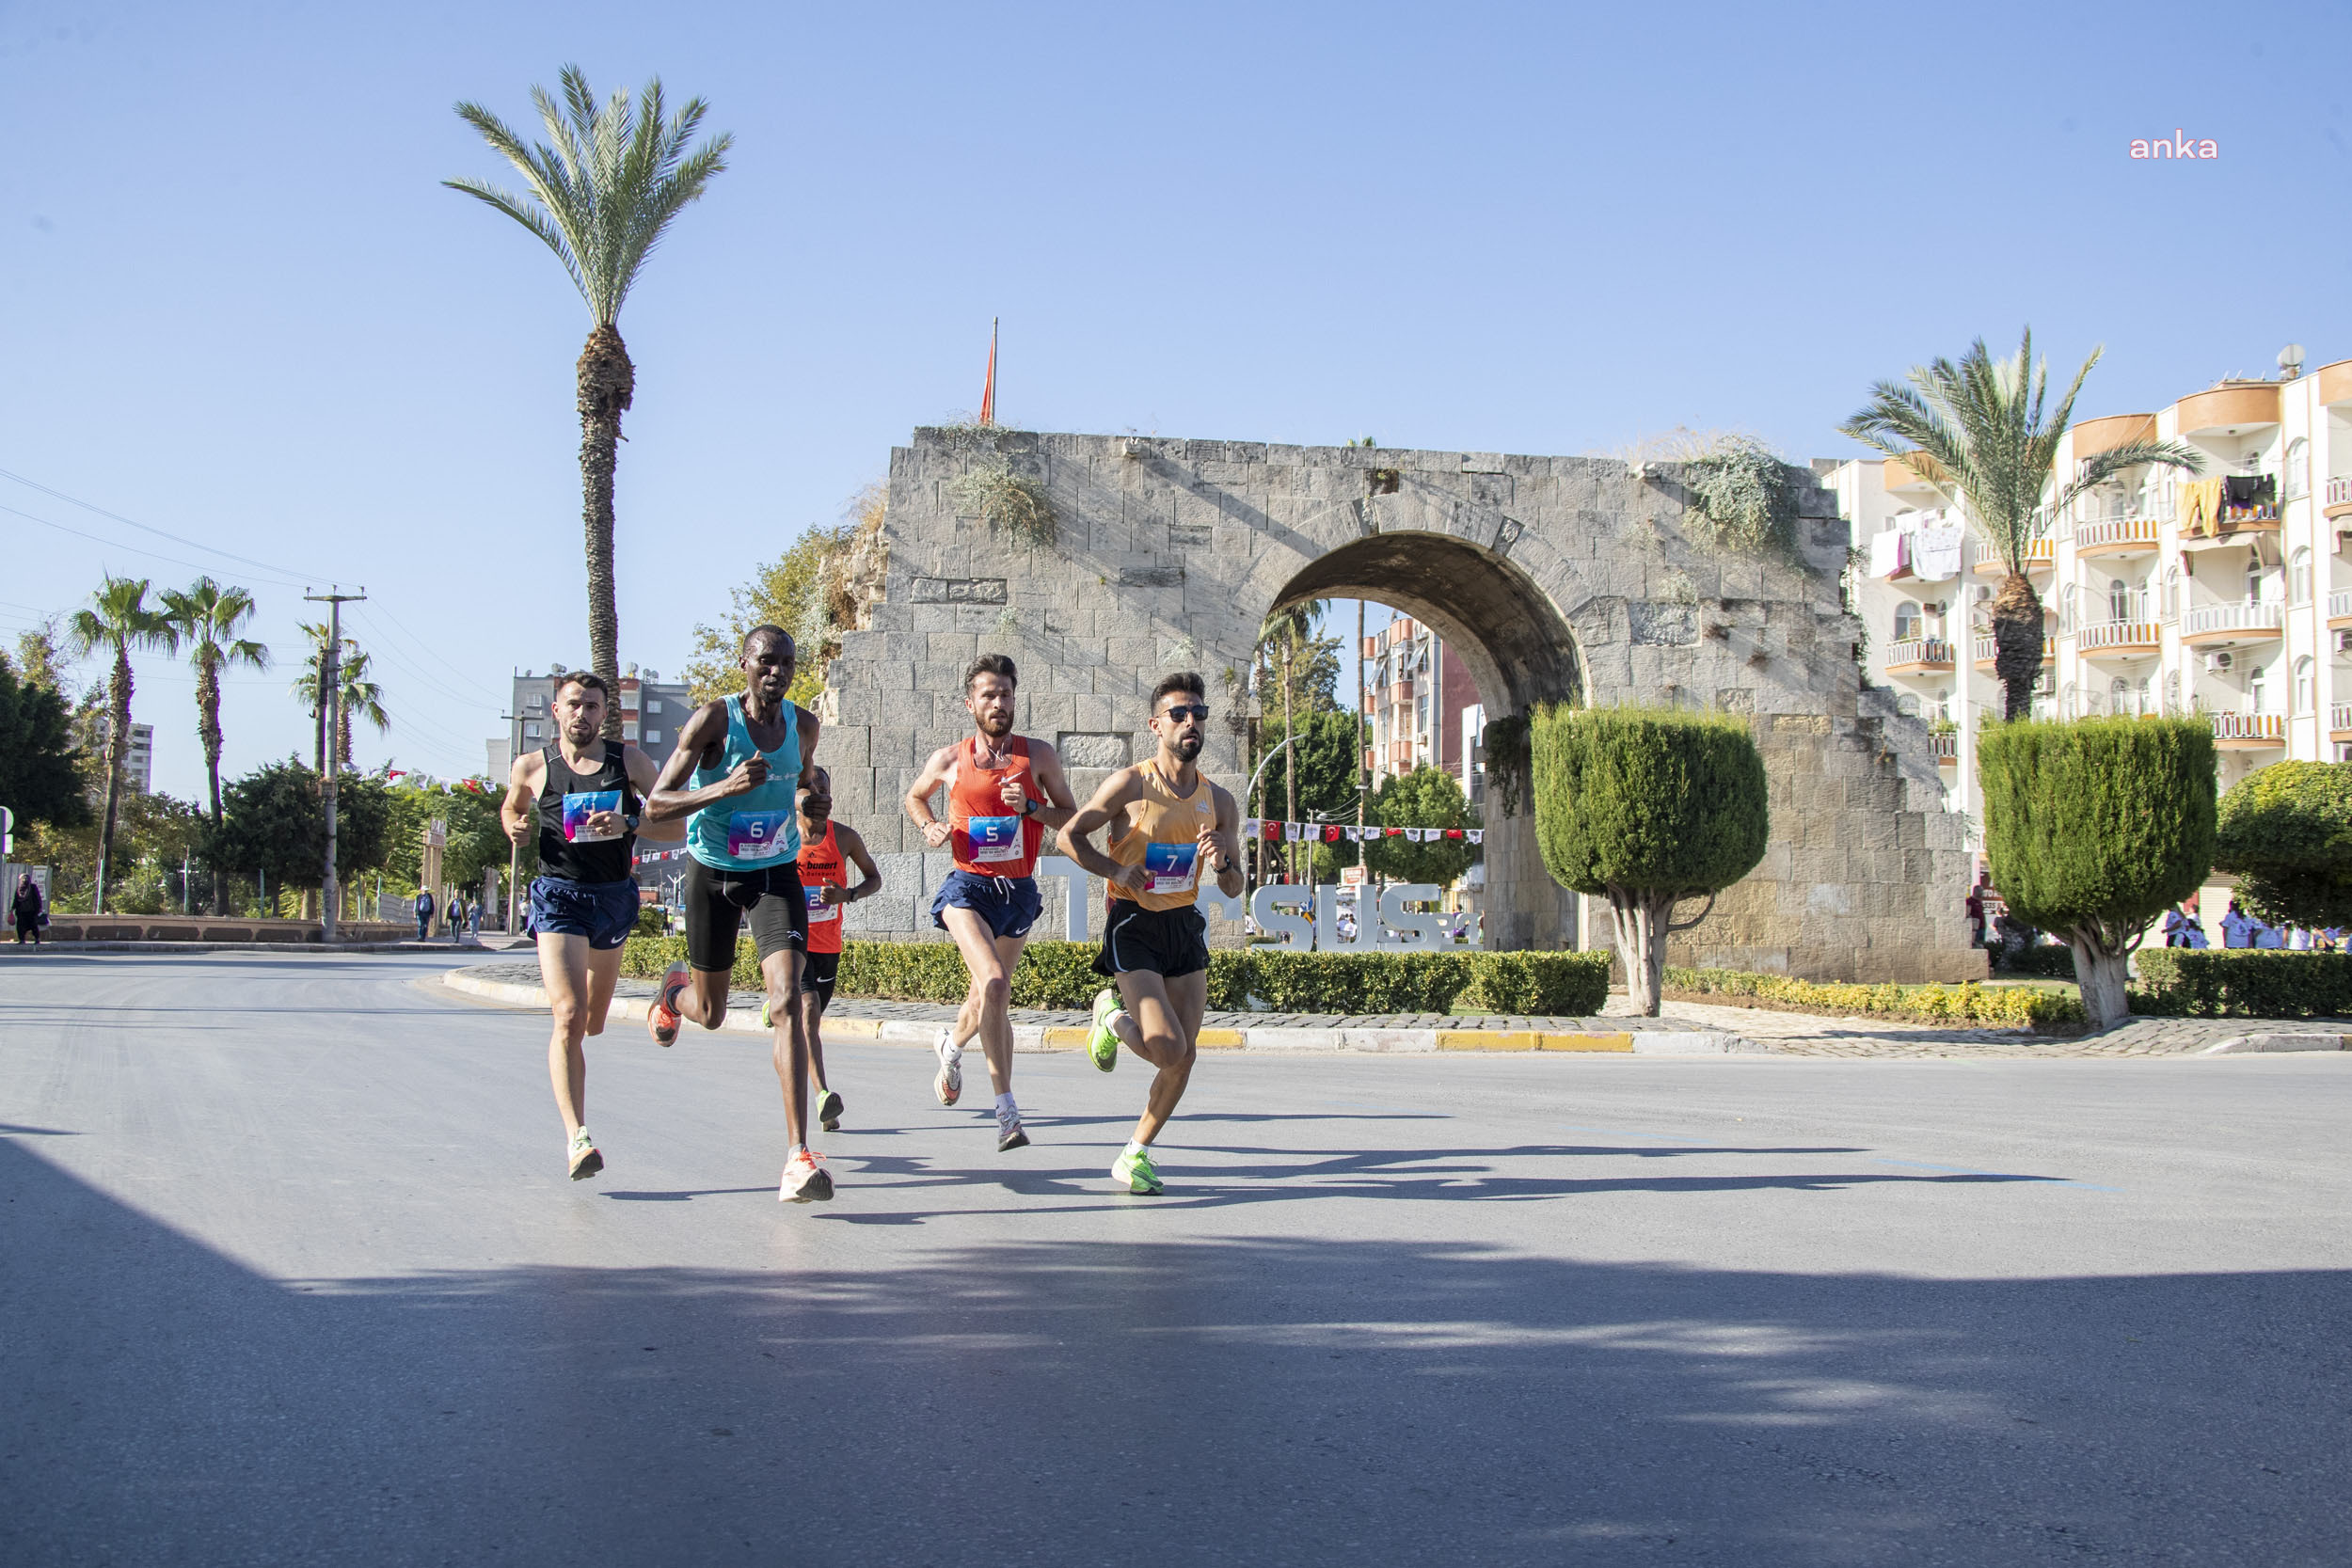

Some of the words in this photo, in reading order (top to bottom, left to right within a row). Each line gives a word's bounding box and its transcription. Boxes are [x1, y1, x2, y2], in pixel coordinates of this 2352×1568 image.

[751, 821, 764, 838] 6
[986, 826, 999, 842] 5
[806, 861, 837, 870] bunert
[1167, 854, 1178, 872] 7
[809, 894, 820, 907] 2
[1038, 856, 1445, 952] Trsus
